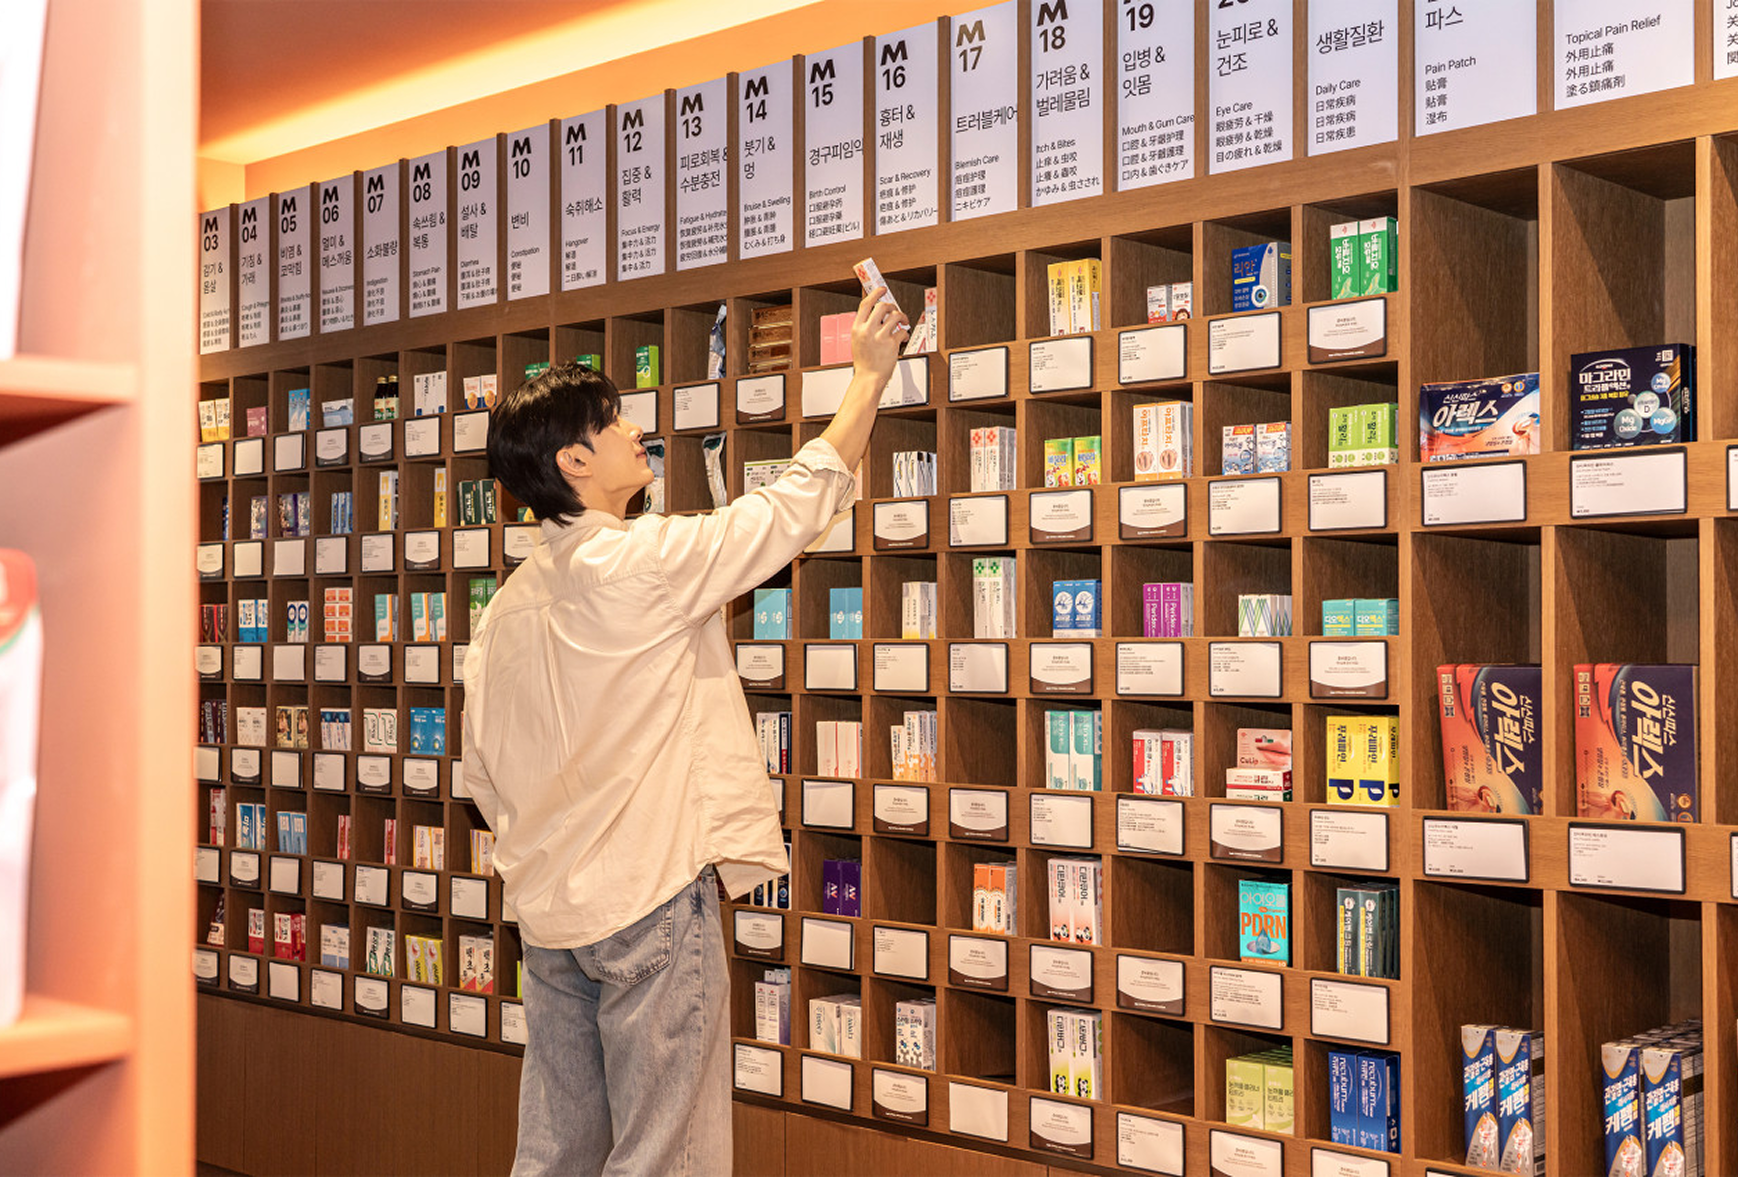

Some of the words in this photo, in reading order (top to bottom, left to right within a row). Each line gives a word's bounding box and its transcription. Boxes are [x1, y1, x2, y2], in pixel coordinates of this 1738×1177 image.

[1125, 2, 1154, 31] 19
[1425, 5, 1463, 30] 파스
[1039, 25, 1066, 52] 18
[1216, 20, 1263, 50] 눈피로
[1266, 18, 1278, 36] &
[1315, 19, 1384, 54] 생활질환
[1565, 27, 1603, 45] Topical
[1604, 22, 1628, 36] Pain
[1630, 14, 1660, 31] Relief
[958, 45, 982, 72] 17
[1122, 46, 1151, 72] 입병
[1154, 45, 1165, 63] &
[1565, 42, 1614, 63] 外用止痛
[1216, 52, 1247, 77] 건조
[1424, 62, 1446, 75] Pain
[1448, 55, 1476, 70] Patch
[1565, 59, 1613, 80] 外用止痛
[882, 64, 905, 90] 16
[1036, 64, 1077, 90] 가려움
[1079, 62, 1090, 80] &
[1122, 73, 1151, 98] 잇몸
[811, 82, 833, 107] 15
[1315, 82, 1338, 96] Daily
[1338, 79, 1361, 91] Care
[746, 98, 767, 123] 14
[1036, 86, 1090, 117] 벌레물림
[1215, 105, 1231, 117] Eye
[1232, 101, 1253, 113] Care
[879, 104, 903, 127] 흉터
[905, 104, 915, 120] &
[1121, 122, 1147, 136] Mouth
[1154, 118, 1174, 129] Gum
[1175, 111, 1194, 125] Care
[682, 115, 702, 139] 13
[623, 130, 642, 153] 12
[744, 136, 764, 157] 붓기
[767, 136, 775, 151] &
[879, 128, 903, 149] 재생
[568, 144, 583, 166] 11
[680, 147, 720, 171] 피로회복
[954, 157, 982, 170] Blemish
[982, 154, 999, 164] Care
[512, 157, 530, 179] 10
[621, 166, 641, 186] 집중
[643, 165, 651, 179] &
[743, 161, 754, 179] 멍
[461, 169, 480, 191] 09
[680, 168, 720, 193] 수분충전
[879, 175, 894, 185] Scar
[367, 192, 384, 213] 07
[412, 181, 431, 203] 08
[322, 204, 339, 224] 06
[438, 211, 445, 224] &
[460, 202, 478, 221] 설사
[479, 201, 486, 215] &
[565, 196, 603, 217] 숙취해소
[280, 214, 297, 234] 05
[510, 211, 529, 229] 변비
[203, 233, 218, 252] 03
[241, 224, 257, 243] 04
[338, 234, 344, 247] &
[256, 252, 262, 265] &
[296, 243, 302, 256] &
[1432, 400, 1498, 428] 아렉스
[1644, 406, 1650, 414] D
[1490, 682, 1525, 774] 아렉스
[1630, 681, 1664, 780] 아렉스
[1240, 912, 1286, 940] PDRN
